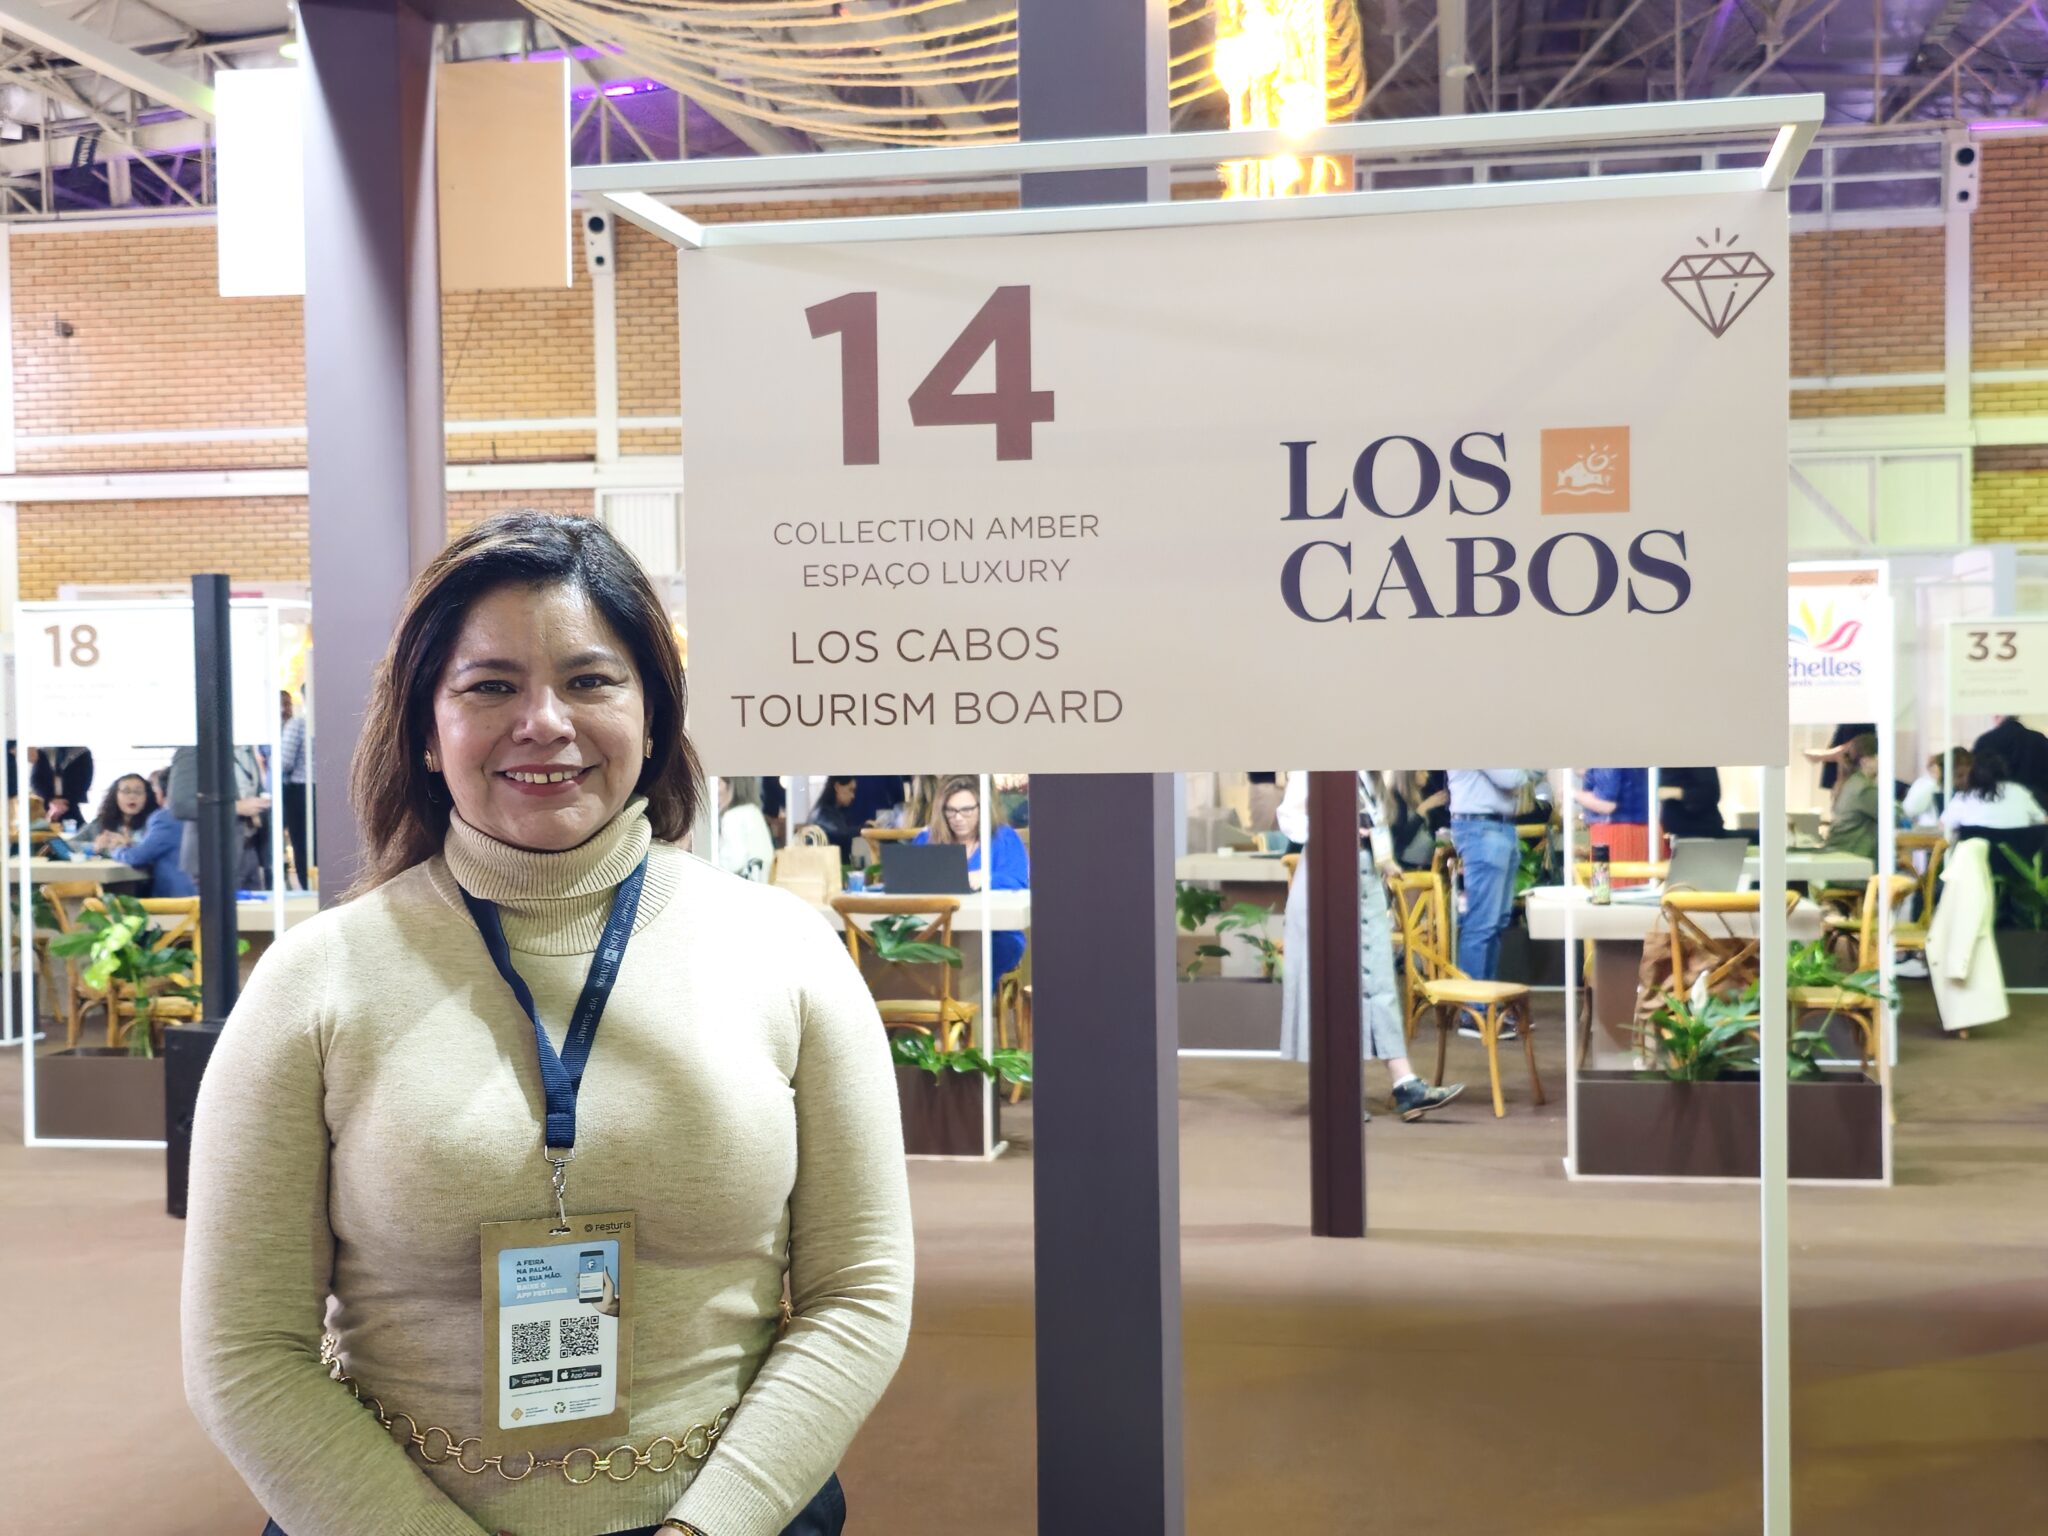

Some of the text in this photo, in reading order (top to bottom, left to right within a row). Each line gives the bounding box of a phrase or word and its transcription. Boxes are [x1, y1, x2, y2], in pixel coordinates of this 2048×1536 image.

[804, 285, 1055, 466] 14
[1280, 431, 1511, 521] LOS
[774, 515, 1098, 545] COLLECTION AMBER
[804, 559, 1070, 589] ESPAÇO LUXURY
[1280, 529, 1691, 623] CABOS
[44, 625, 99, 667] 18
[792, 626, 1059, 664] LOS CABOS
[1967, 631, 2018, 662] 33
[731, 690, 1122, 727] TOURISM BOARD
[576, 997, 599, 1044] VIP SUMMIT
[523, 1258, 545, 1266] FEIRA
[529, 1265, 552, 1273] PALMA
